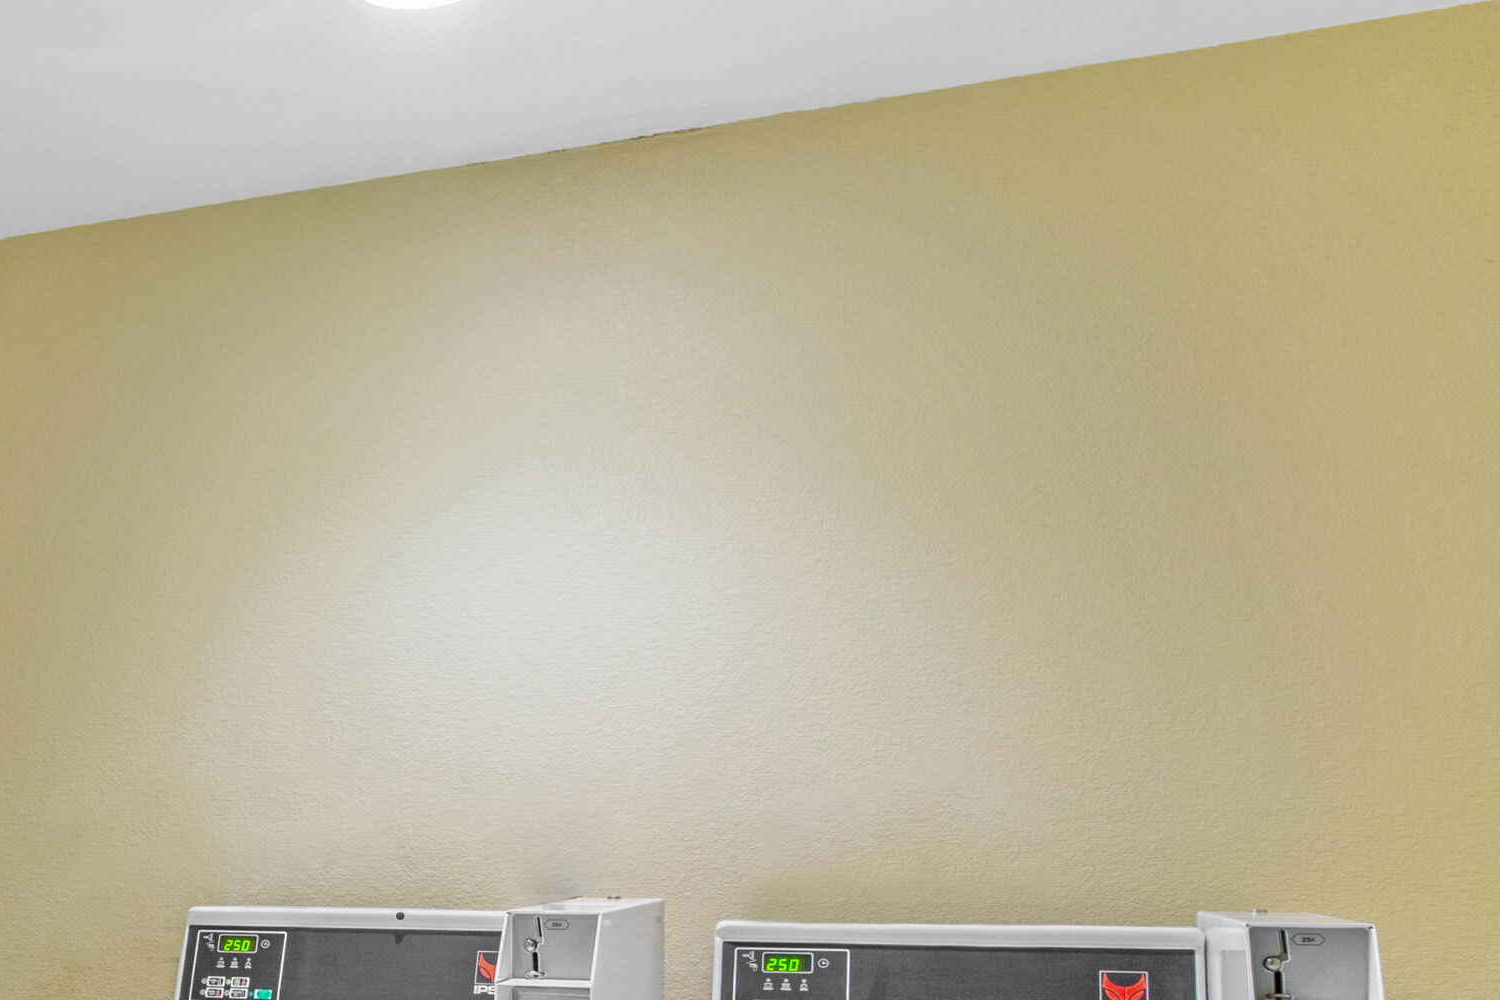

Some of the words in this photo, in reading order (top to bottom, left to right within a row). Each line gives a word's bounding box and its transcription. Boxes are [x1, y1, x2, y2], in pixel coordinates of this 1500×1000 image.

[224, 940, 250, 952] 250
[766, 959, 800, 971] 250
[473, 985, 495, 994] IPS
